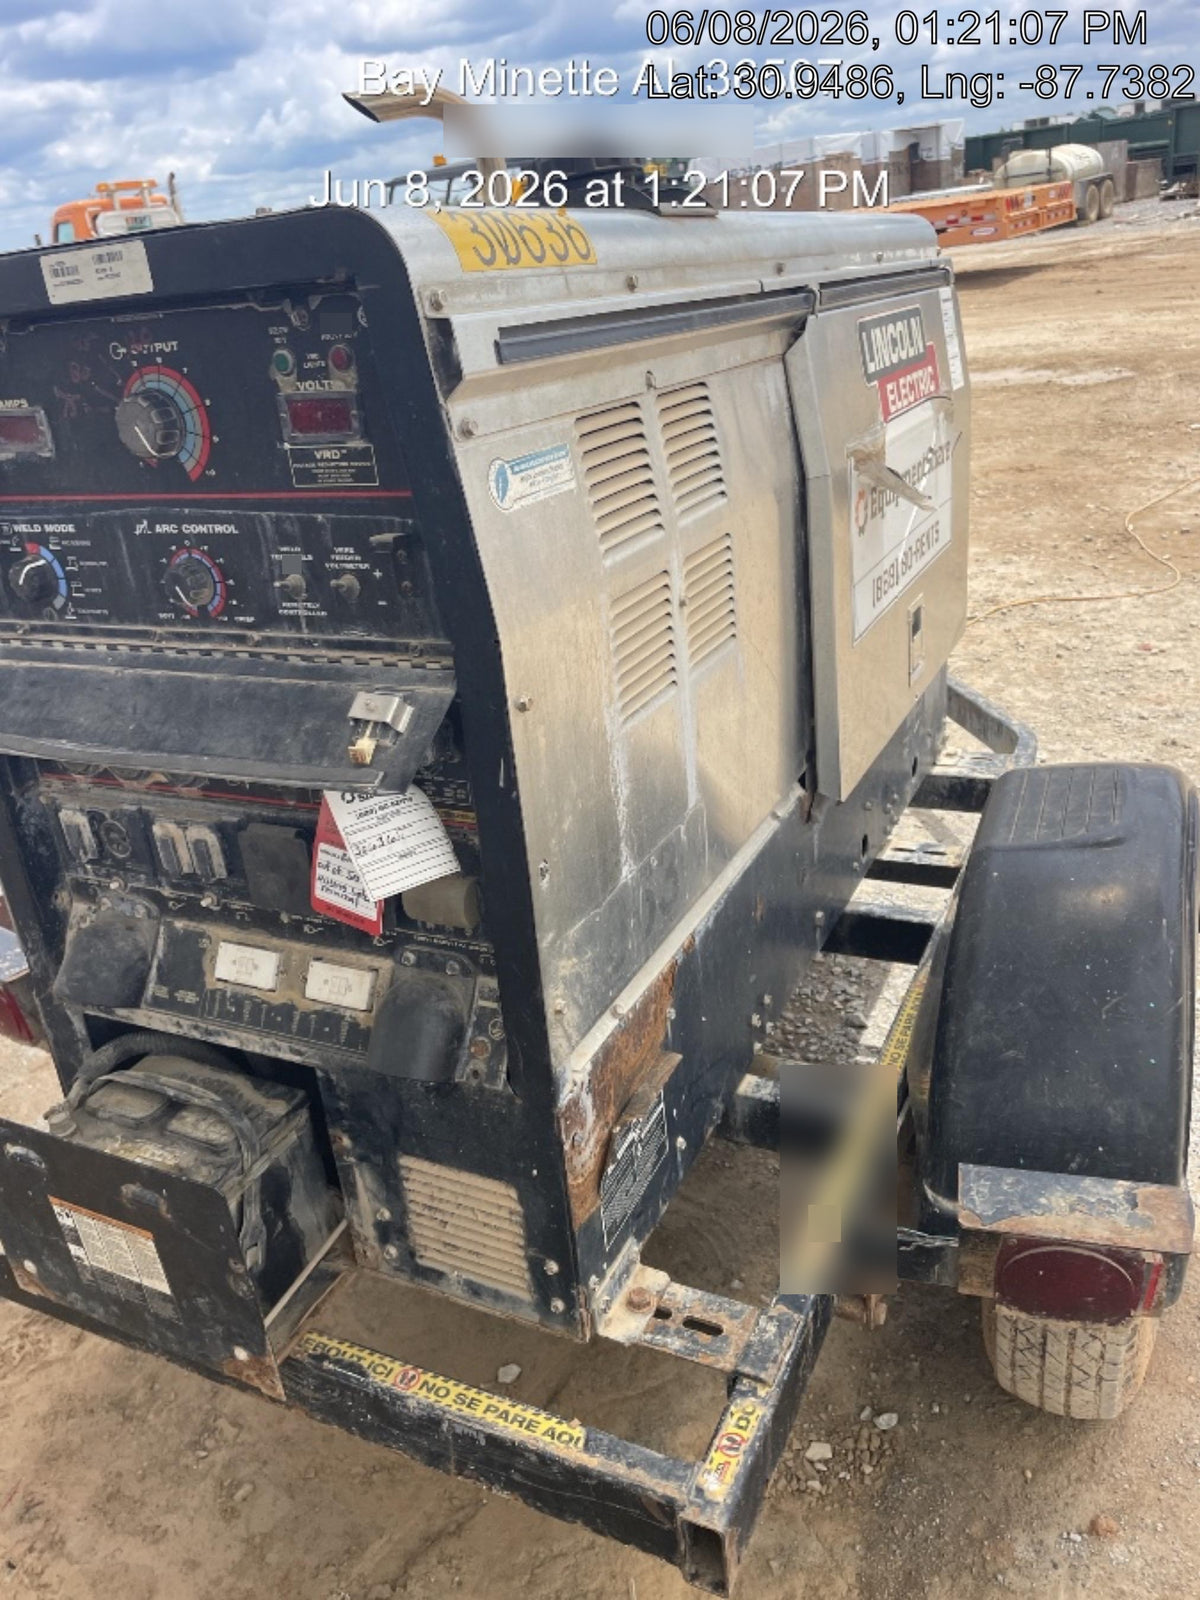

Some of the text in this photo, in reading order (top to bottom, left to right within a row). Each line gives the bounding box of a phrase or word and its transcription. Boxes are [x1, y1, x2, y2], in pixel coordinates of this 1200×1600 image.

[445, 211, 591, 266] 30636
[862, 315, 924, 375] LINCOLN
[886, 365, 936, 414] ELECTRIC
[12, 523, 76, 533] WELD MODE
[155, 523, 240, 534] ARC CONTROL
[367, 1359, 394, 1379] ICI
[418, 1379, 451, 1399] NO
[452, 1392, 483, 1411] SE
[483, 1403, 541, 1434] PARE
